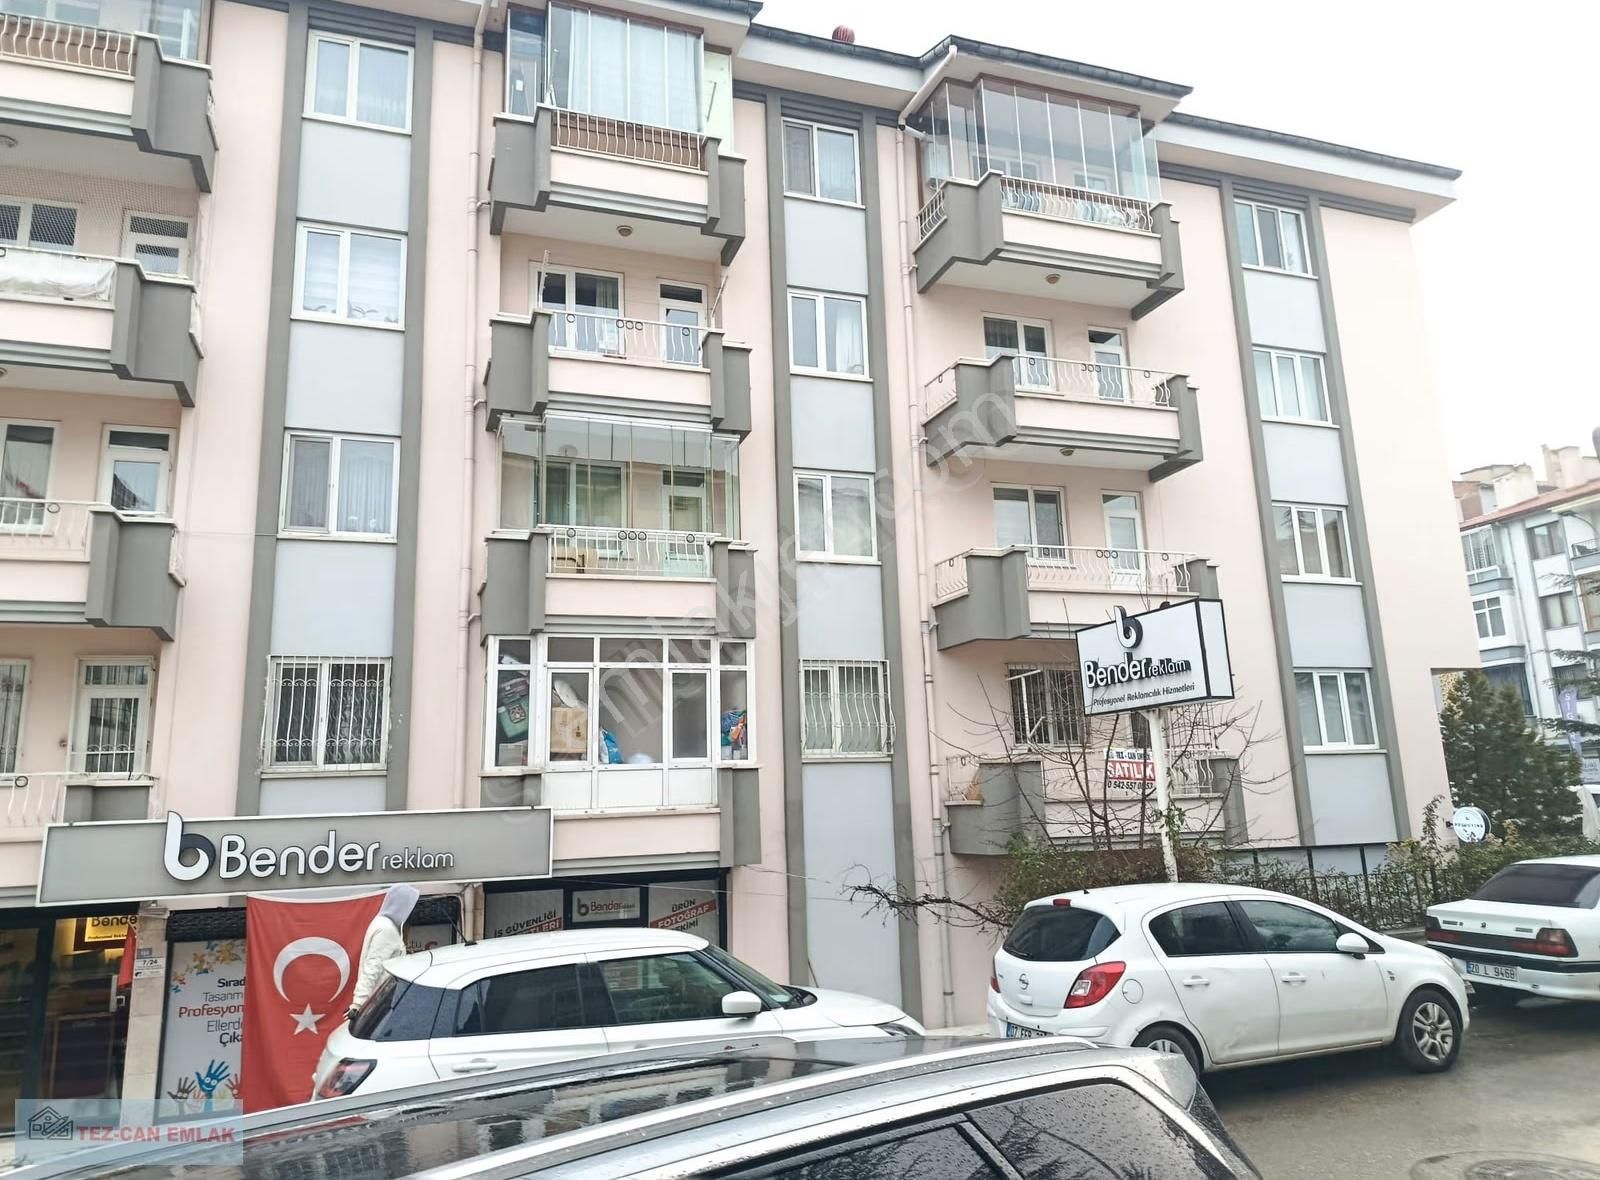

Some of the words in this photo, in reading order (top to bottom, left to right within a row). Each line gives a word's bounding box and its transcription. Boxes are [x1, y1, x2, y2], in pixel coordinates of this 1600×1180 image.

[1084, 652, 1149, 688] Bender
[1149, 658, 1188, 677] reklam
[1093, 694, 1126, 706] Profesyonel
[1127, 687, 1161, 701] Reklamcılık
[1162, 682, 1195, 696] Hizmetleri
[1106, 762, 1155, 779] SATILIK
[219, 830, 380, 880] Bender
[381, 847, 454, 870] reklam
[590, 900, 623, 912] Bender
[91, 915, 138, 928] Bende
[505, 907, 557, 934] GÜVENLİĞİ
